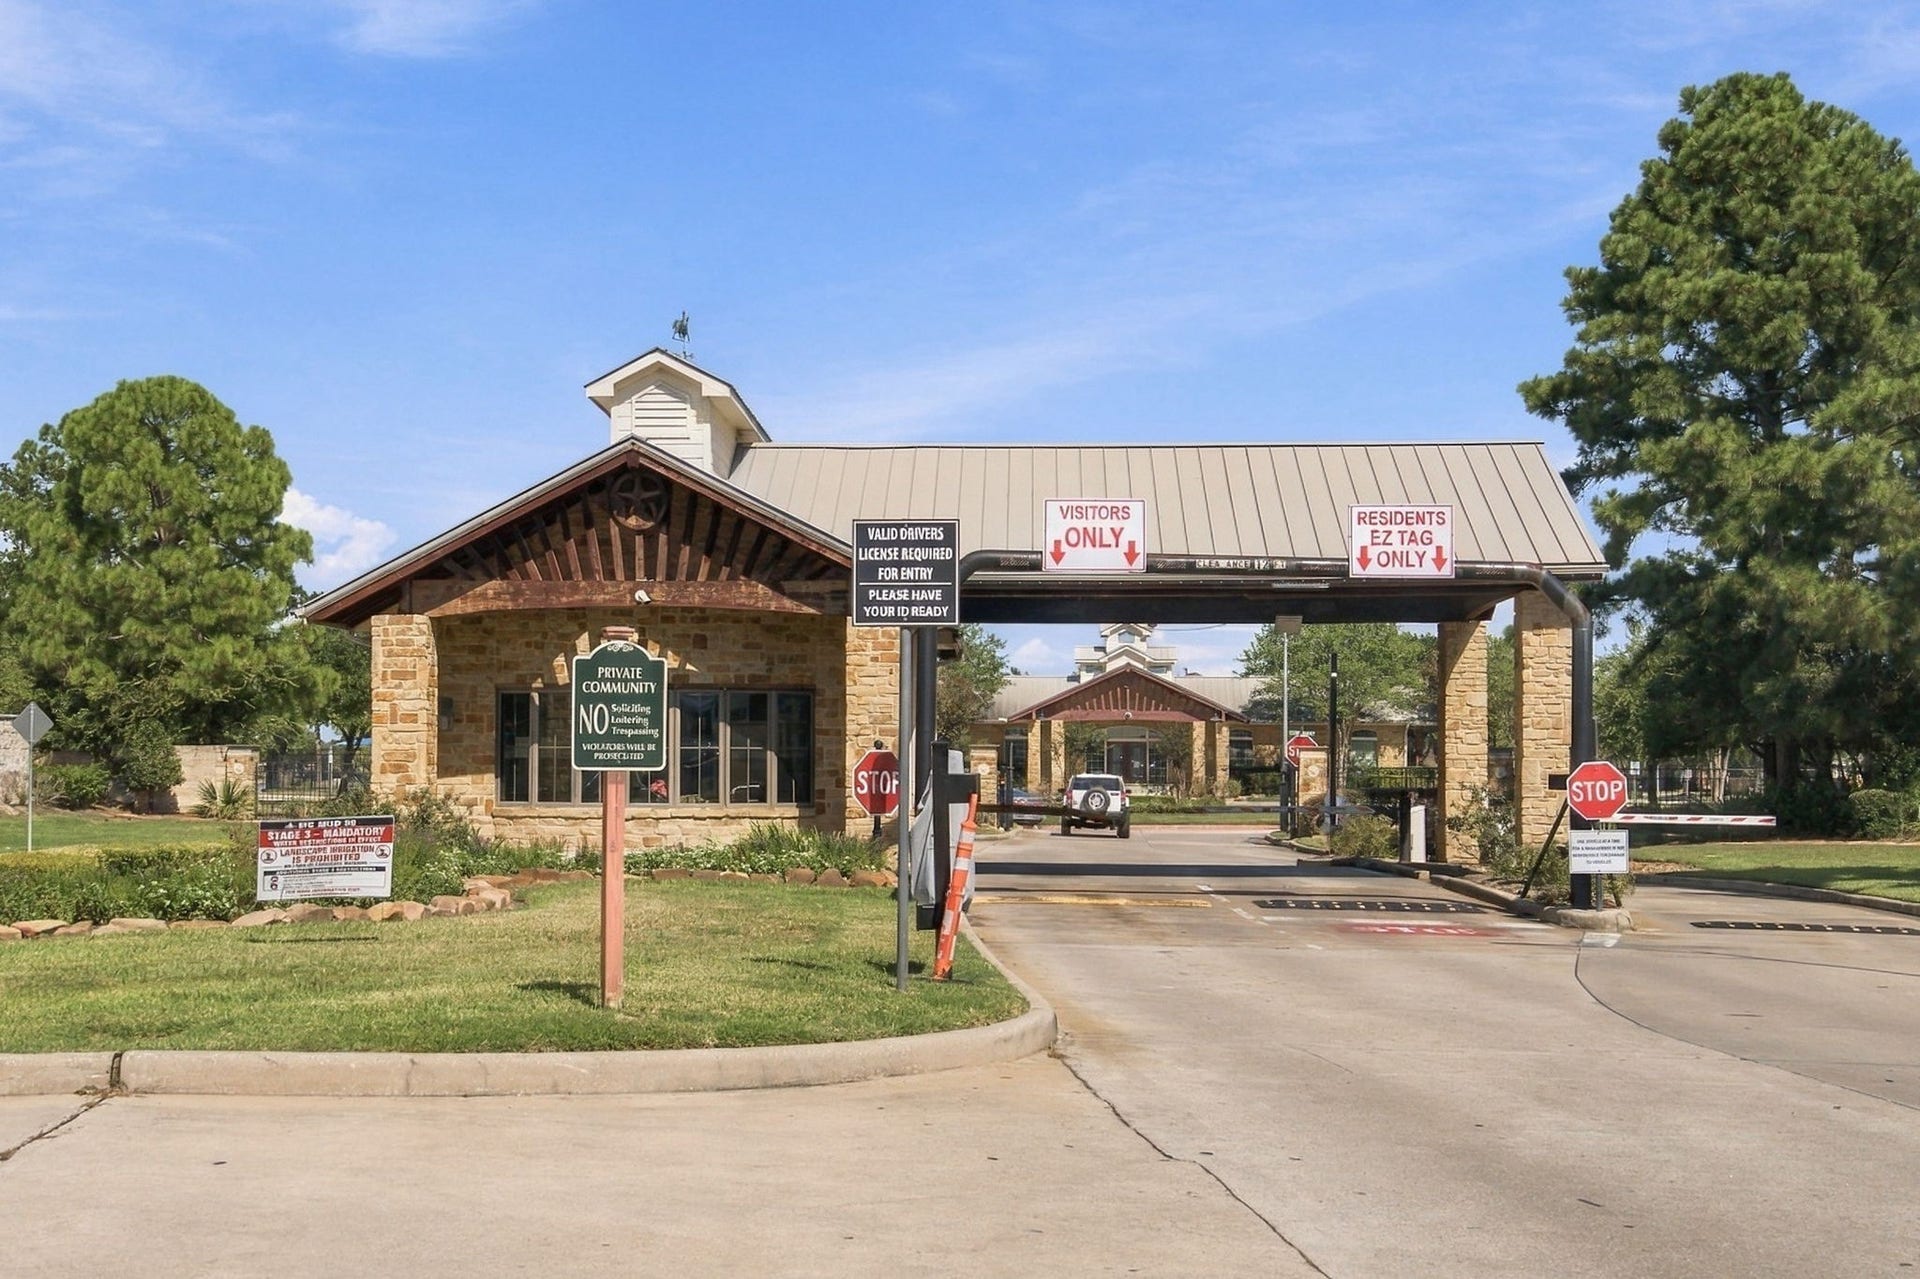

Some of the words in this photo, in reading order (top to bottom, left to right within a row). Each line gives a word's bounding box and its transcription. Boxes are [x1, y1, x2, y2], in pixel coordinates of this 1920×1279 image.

[1059, 505, 1131, 520] VISITORS
[1357, 511, 1446, 526] RESIDENTS
[868, 527, 898, 540] VALID
[900, 527, 944, 540] DRIVERS
[1065, 527, 1124, 548] ONLY
[1370, 529, 1393, 546] EZ
[1398, 529, 1433, 546] TAG
[859, 547, 899, 560] LICENSE
[901, 547, 953, 561] REQUIRED
[1377, 550, 1427, 568] ONLY
[1197, 559, 1249, 568] CLEAANCE
[878, 567, 899, 580] FOR
[900, 567, 933, 580] ENTRY
[869, 589, 910, 601] PLEASE
[912, 589, 942, 600] HAVE
[863, 606, 895, 617] YOUR
[897, 606, 909, 617] ID
[911, 606, 949, 617] READY
[598, 667, 643, 679] PRIVATE
[582, 681, 657, 694] COMMUNITY
[611, 704, 651, 714] Soliciting
[579, 703, 610, 735] NO
[611, 716, 649, 726] Loitering
[611, 727, 659, 738] Trespassing
[582, 743, 626, 751] VIOLATORS
[626, 743, 645, 751] WILL
[1571, 780, 1623, 803] STOP
[267, 830, 301, 841] STAGE
[304, 830, 311, 839] 3
[323, 826, 386, 838] MANDATORY
[280, 848, 328, 857] LANDSCAPE
[330, 845, 375, 854] IRRIGATION
[292, 855, 301, 864] IS
[304, 853, 361, 864] PROHIBITED
